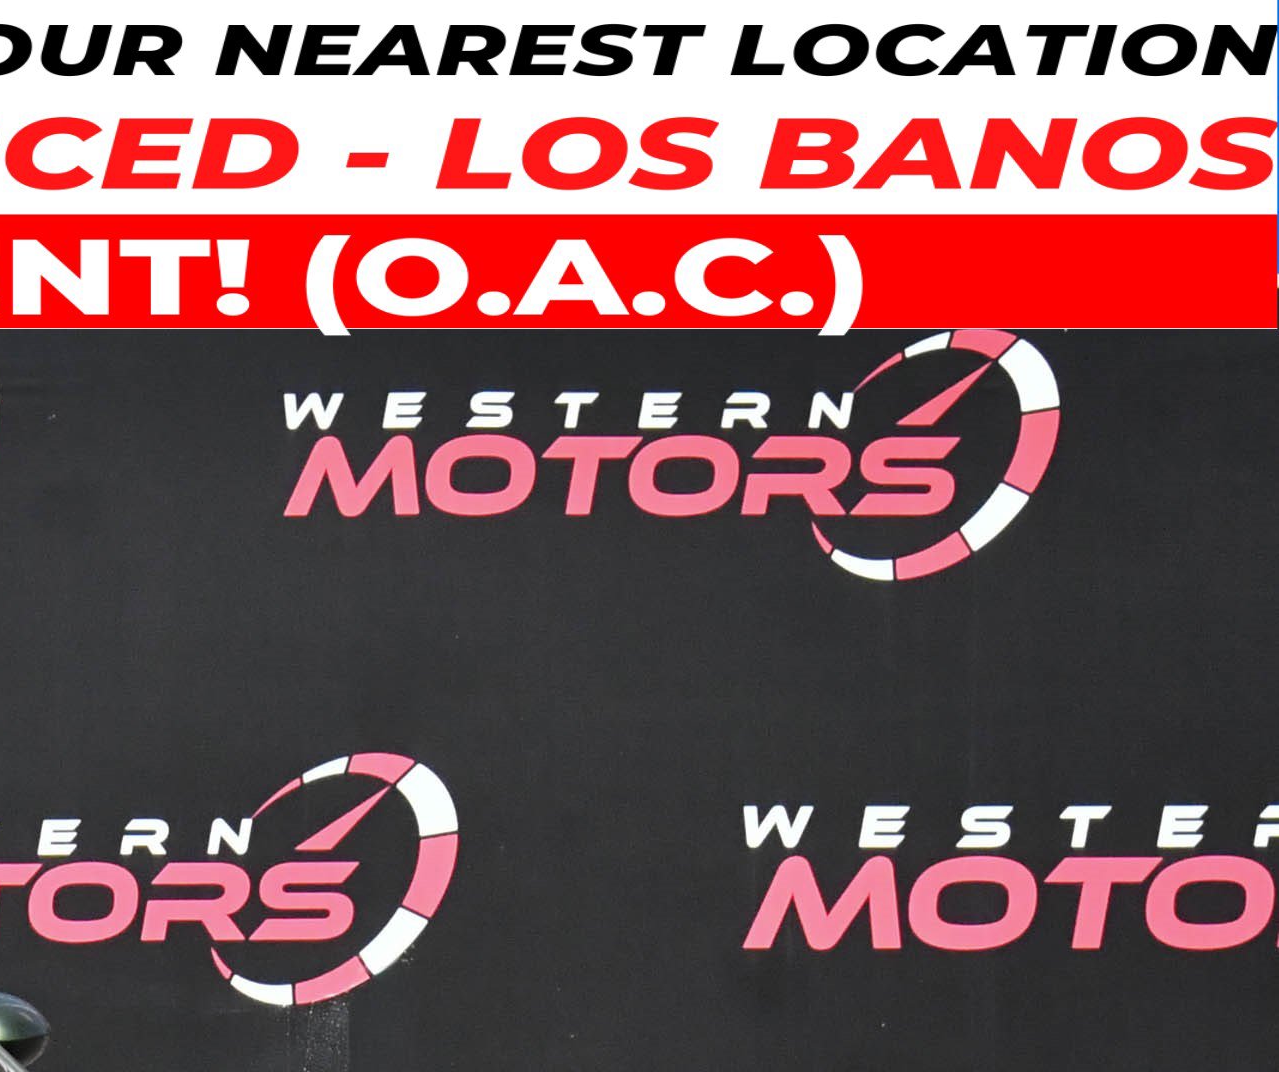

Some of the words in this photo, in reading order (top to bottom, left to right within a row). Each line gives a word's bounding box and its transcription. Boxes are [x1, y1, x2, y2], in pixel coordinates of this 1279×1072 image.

[283, 391, 855, 430] WESTERN
[283, 434, 962, 519] MOTORS
[742, 855, 1279, 951] MOTO
